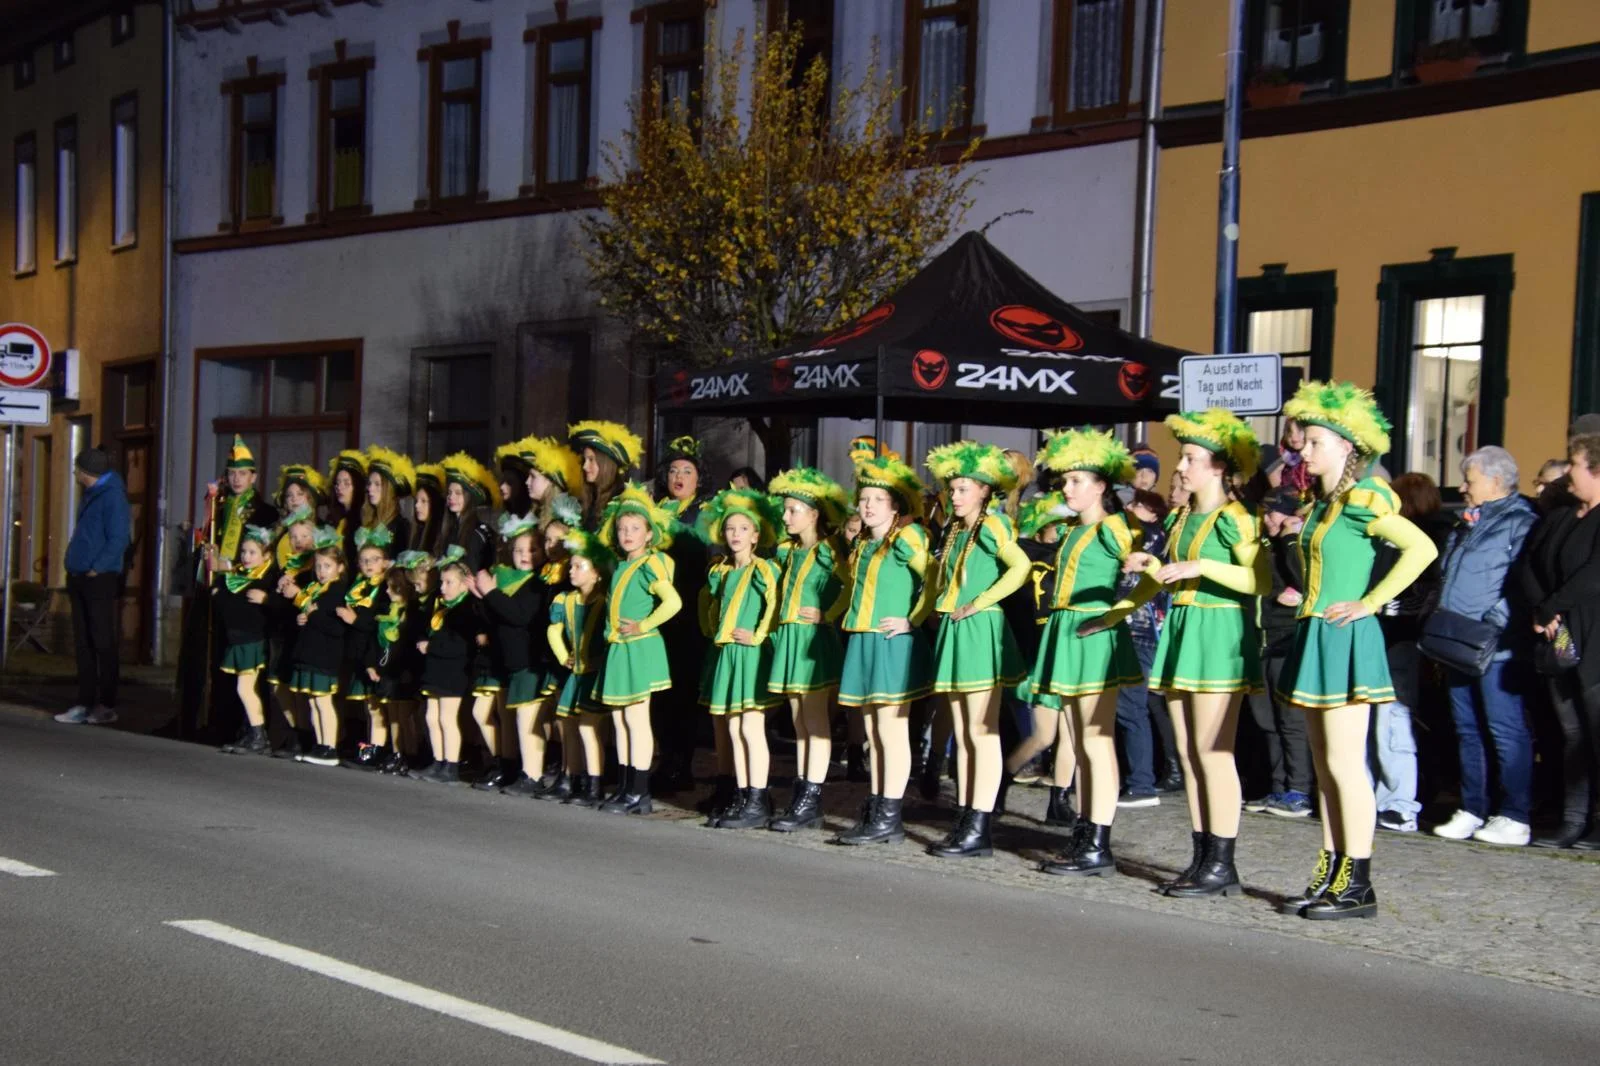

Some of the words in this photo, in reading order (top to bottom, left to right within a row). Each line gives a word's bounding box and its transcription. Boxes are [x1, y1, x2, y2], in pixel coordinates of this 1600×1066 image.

[794, 363, 860, 388] 24MX
[1203, 362, 1258, 375] Ausfahrt
[691, 373, 750, 399] 24MX
[955, 363, 1077, 395] 24MX
[1198, 380, 1214, 394] Tag
[1217, 380, 1233, 391] und
[1237, 379, 1263, 390] Nacht
[1206, 396, 1253, 408] freihalten
